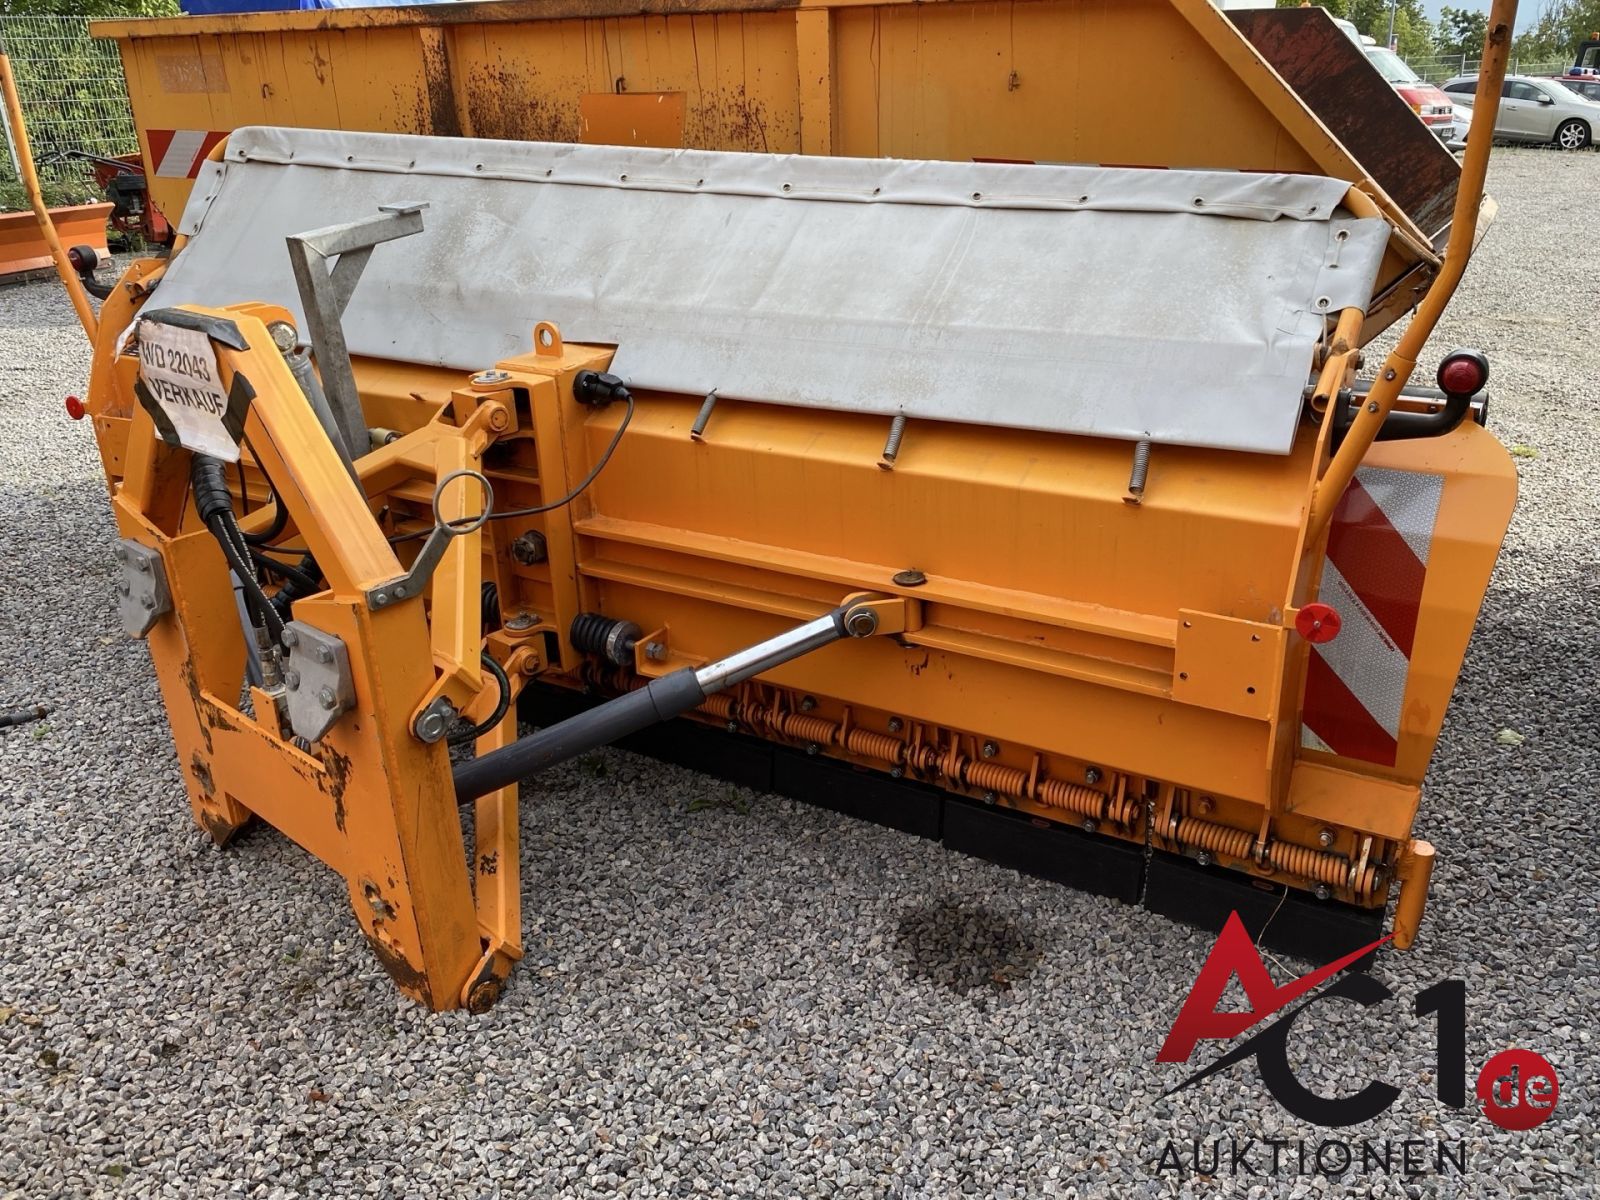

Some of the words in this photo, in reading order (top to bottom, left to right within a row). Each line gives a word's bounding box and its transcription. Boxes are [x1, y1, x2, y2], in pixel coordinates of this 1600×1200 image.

[141, 341, 166, 369] WD
[168, 348, 211, 383] 22043
[148, 377, 224, 417] VERKAUF
